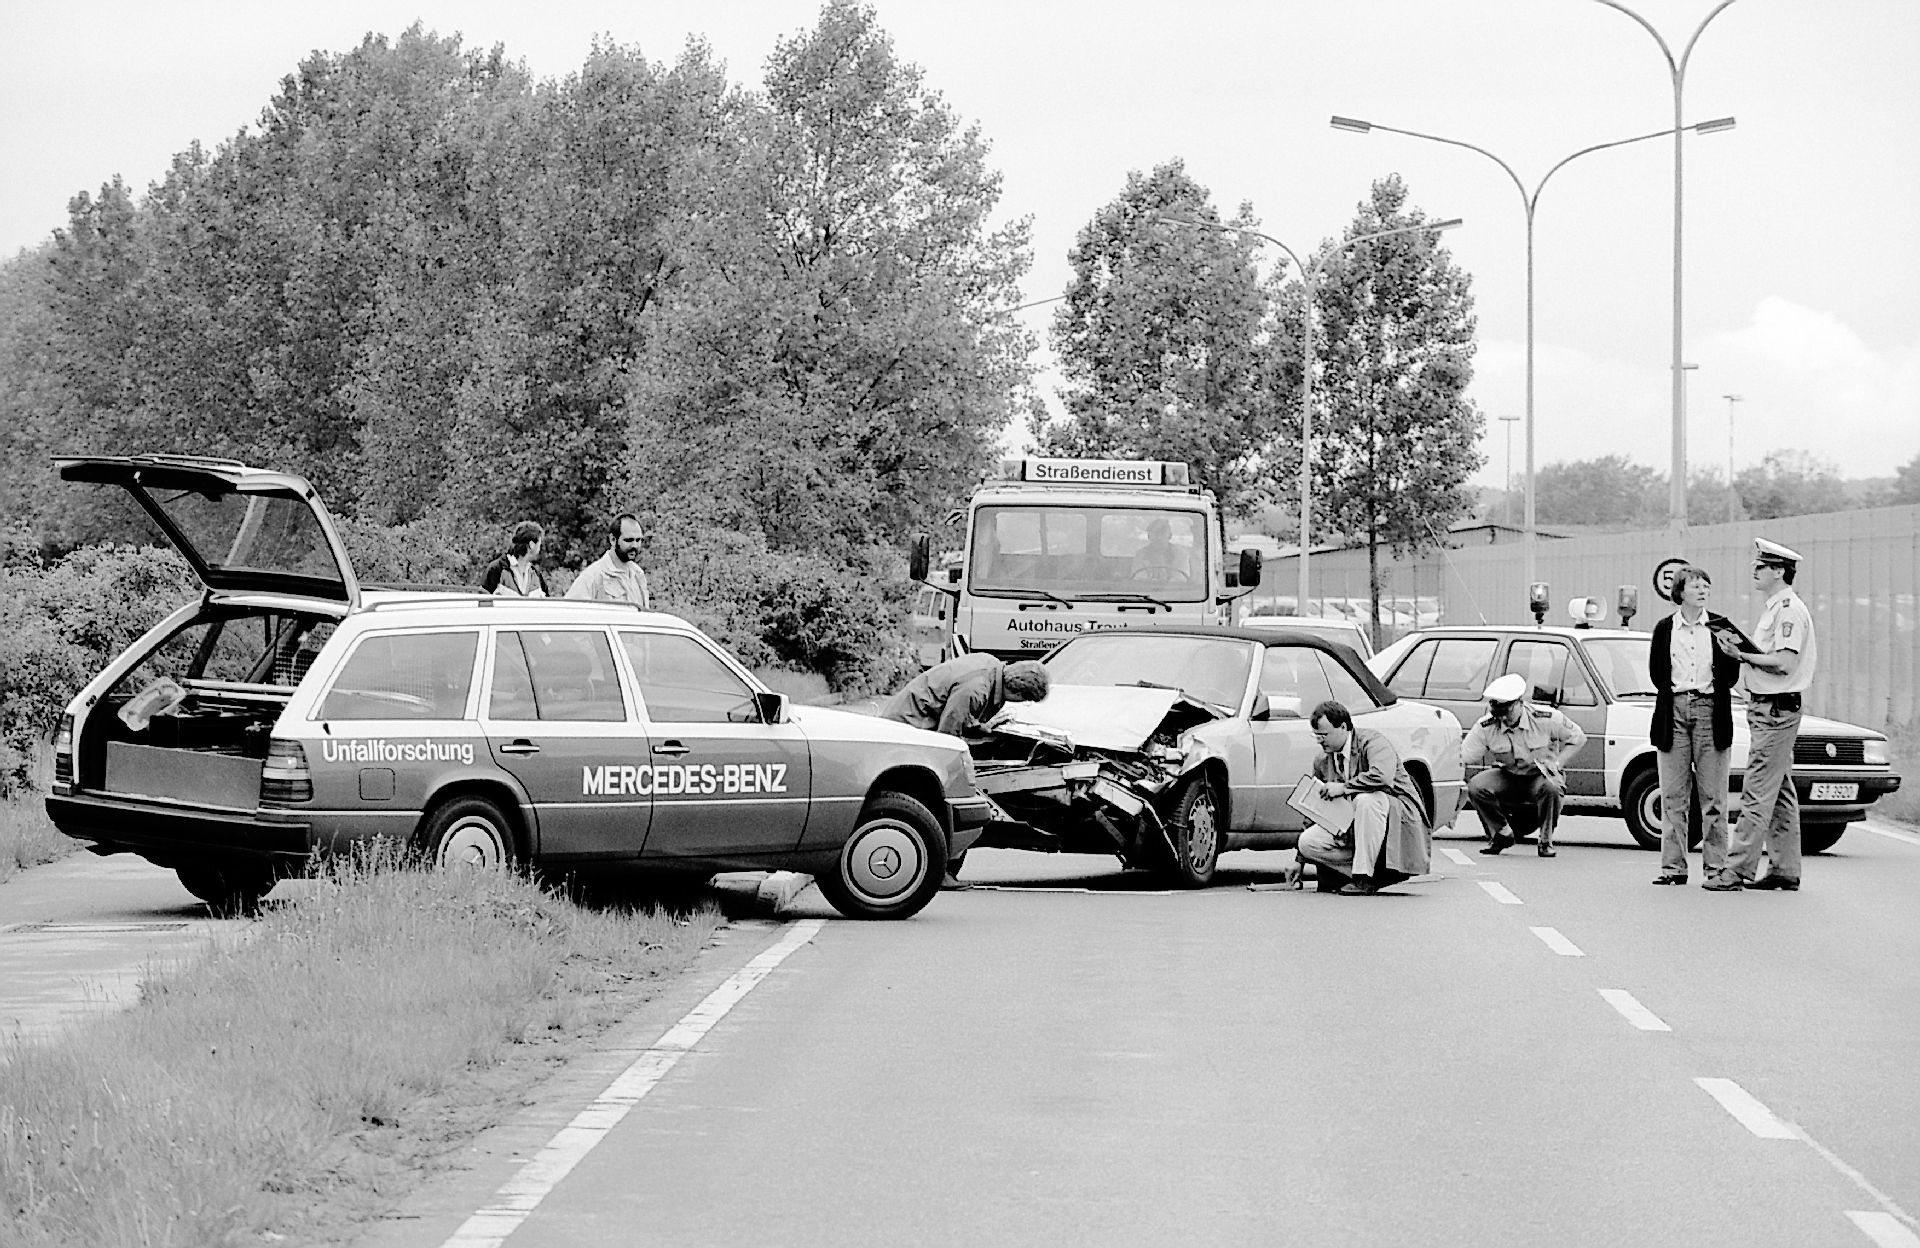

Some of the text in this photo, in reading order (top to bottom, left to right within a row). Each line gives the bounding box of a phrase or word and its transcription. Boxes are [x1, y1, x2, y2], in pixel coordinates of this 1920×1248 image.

[1035, 463, 1153, 481] Straßendienst
[1007, 618, 1082, 633] Autohaus
[322, 738, 474, 765] Unfallforschung
[582, 763, 788, 795] MERCEDES-BENZ
